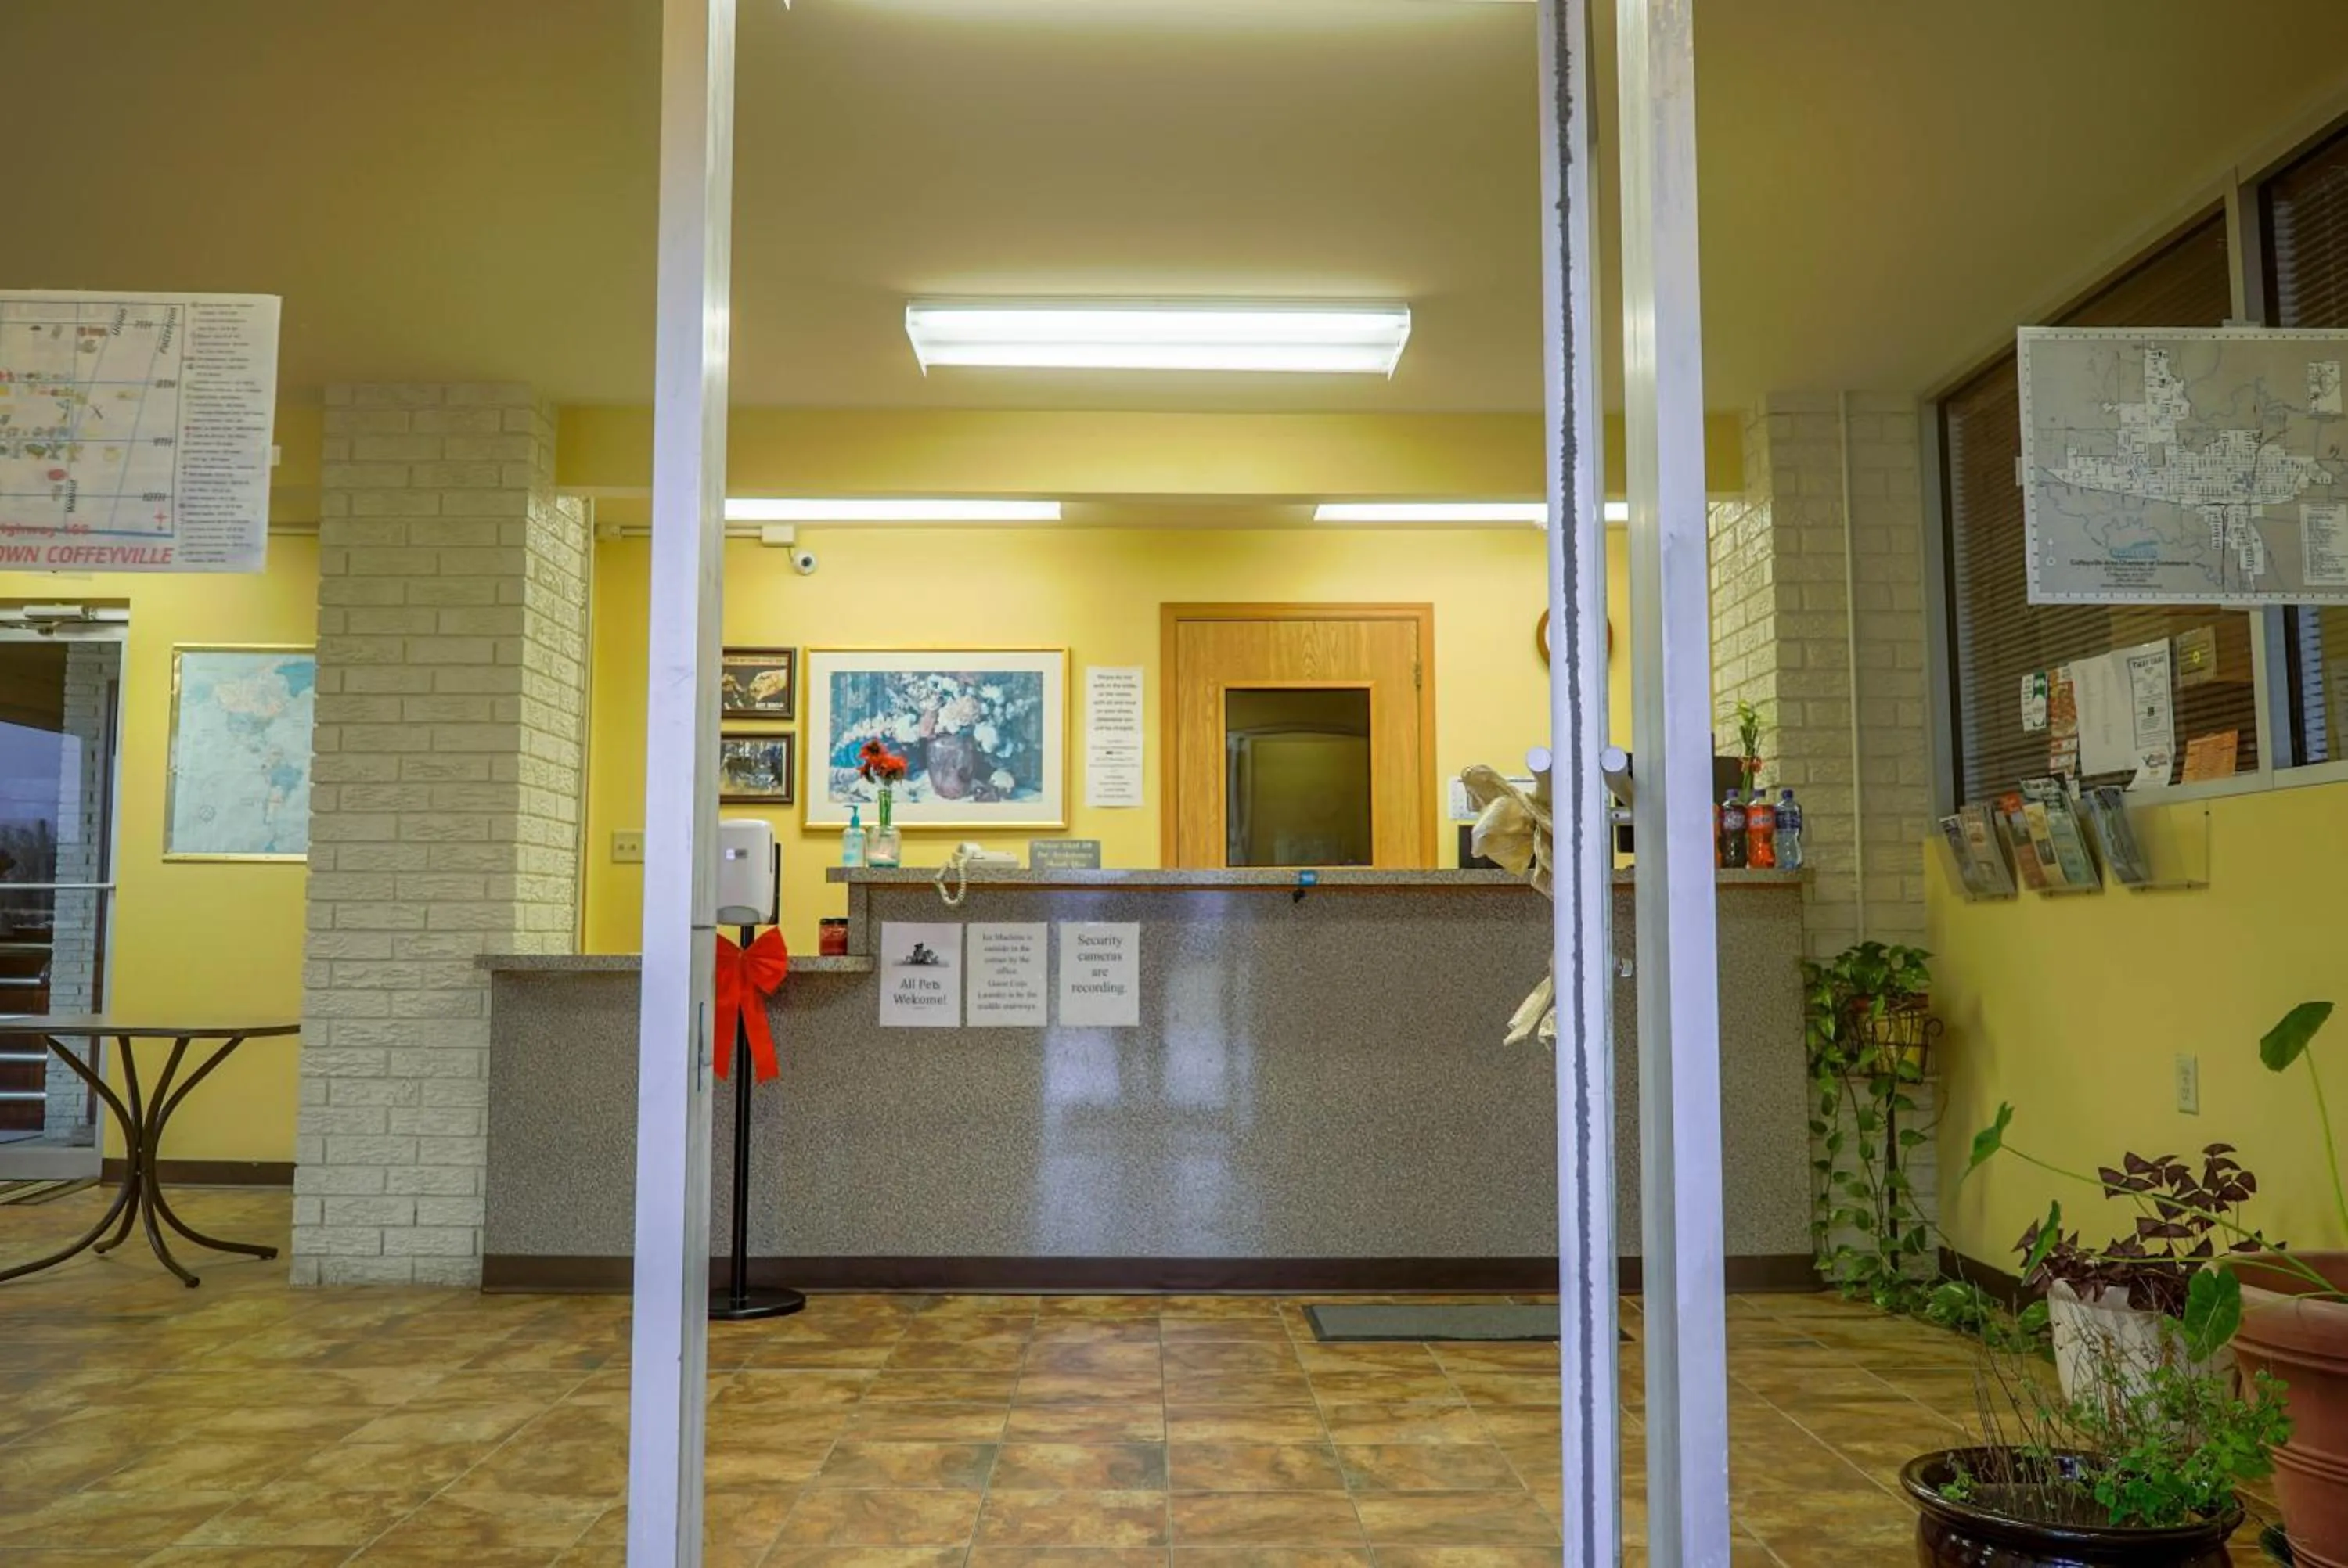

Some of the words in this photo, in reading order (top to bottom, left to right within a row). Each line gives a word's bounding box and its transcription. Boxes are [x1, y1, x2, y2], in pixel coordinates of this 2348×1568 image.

[47, 545, 175, 565] COFFEYVILLE
[1077, 933, 1123, 948] Security
[1076, 952, 1123, 962] cameras
[1091, 968, 1109, 978] are
[899, 977, 916, 990] All
[918, 978, 941, 990] Pets
[1071, 980, 1128, 997] recording.
[893, 993, 948, 1005] Welcome!
